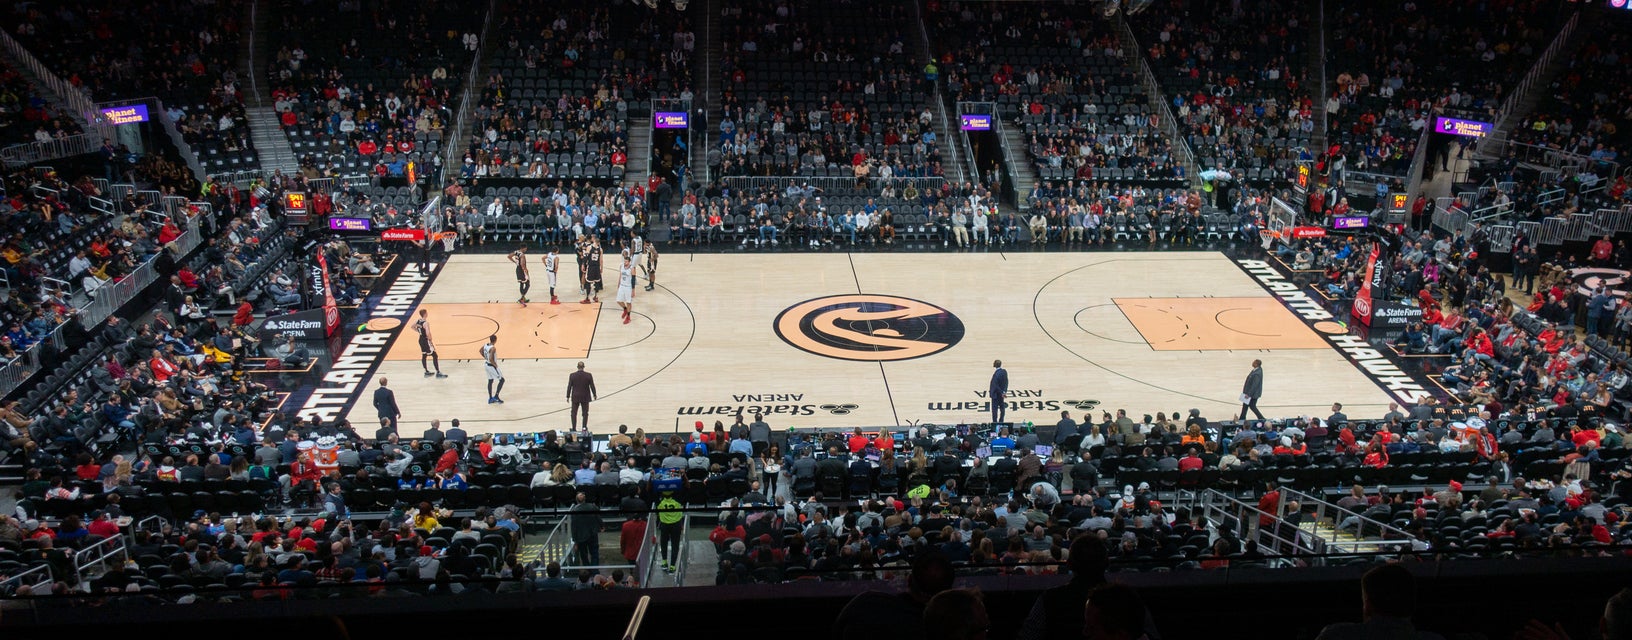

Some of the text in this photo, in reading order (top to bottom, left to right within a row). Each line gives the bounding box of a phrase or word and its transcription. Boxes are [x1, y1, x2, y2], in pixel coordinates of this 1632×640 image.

[105, 108, 136, 120] planet
[113, 115, 143, 124] itness
[1455, 122, 1482, 130] planet
[312, 265, 325, 295] xfinity
[1371, 260, 1384, 288] xfinity
[1237, 259, 1334, 320] ATLANTA
[297, 332, 392, 422] ATLANTA
[1328, 335, 1432, 404] HAWKS
[732, 393, 804, 402] ARENA
[974, 389, 1043, 398] AREA
